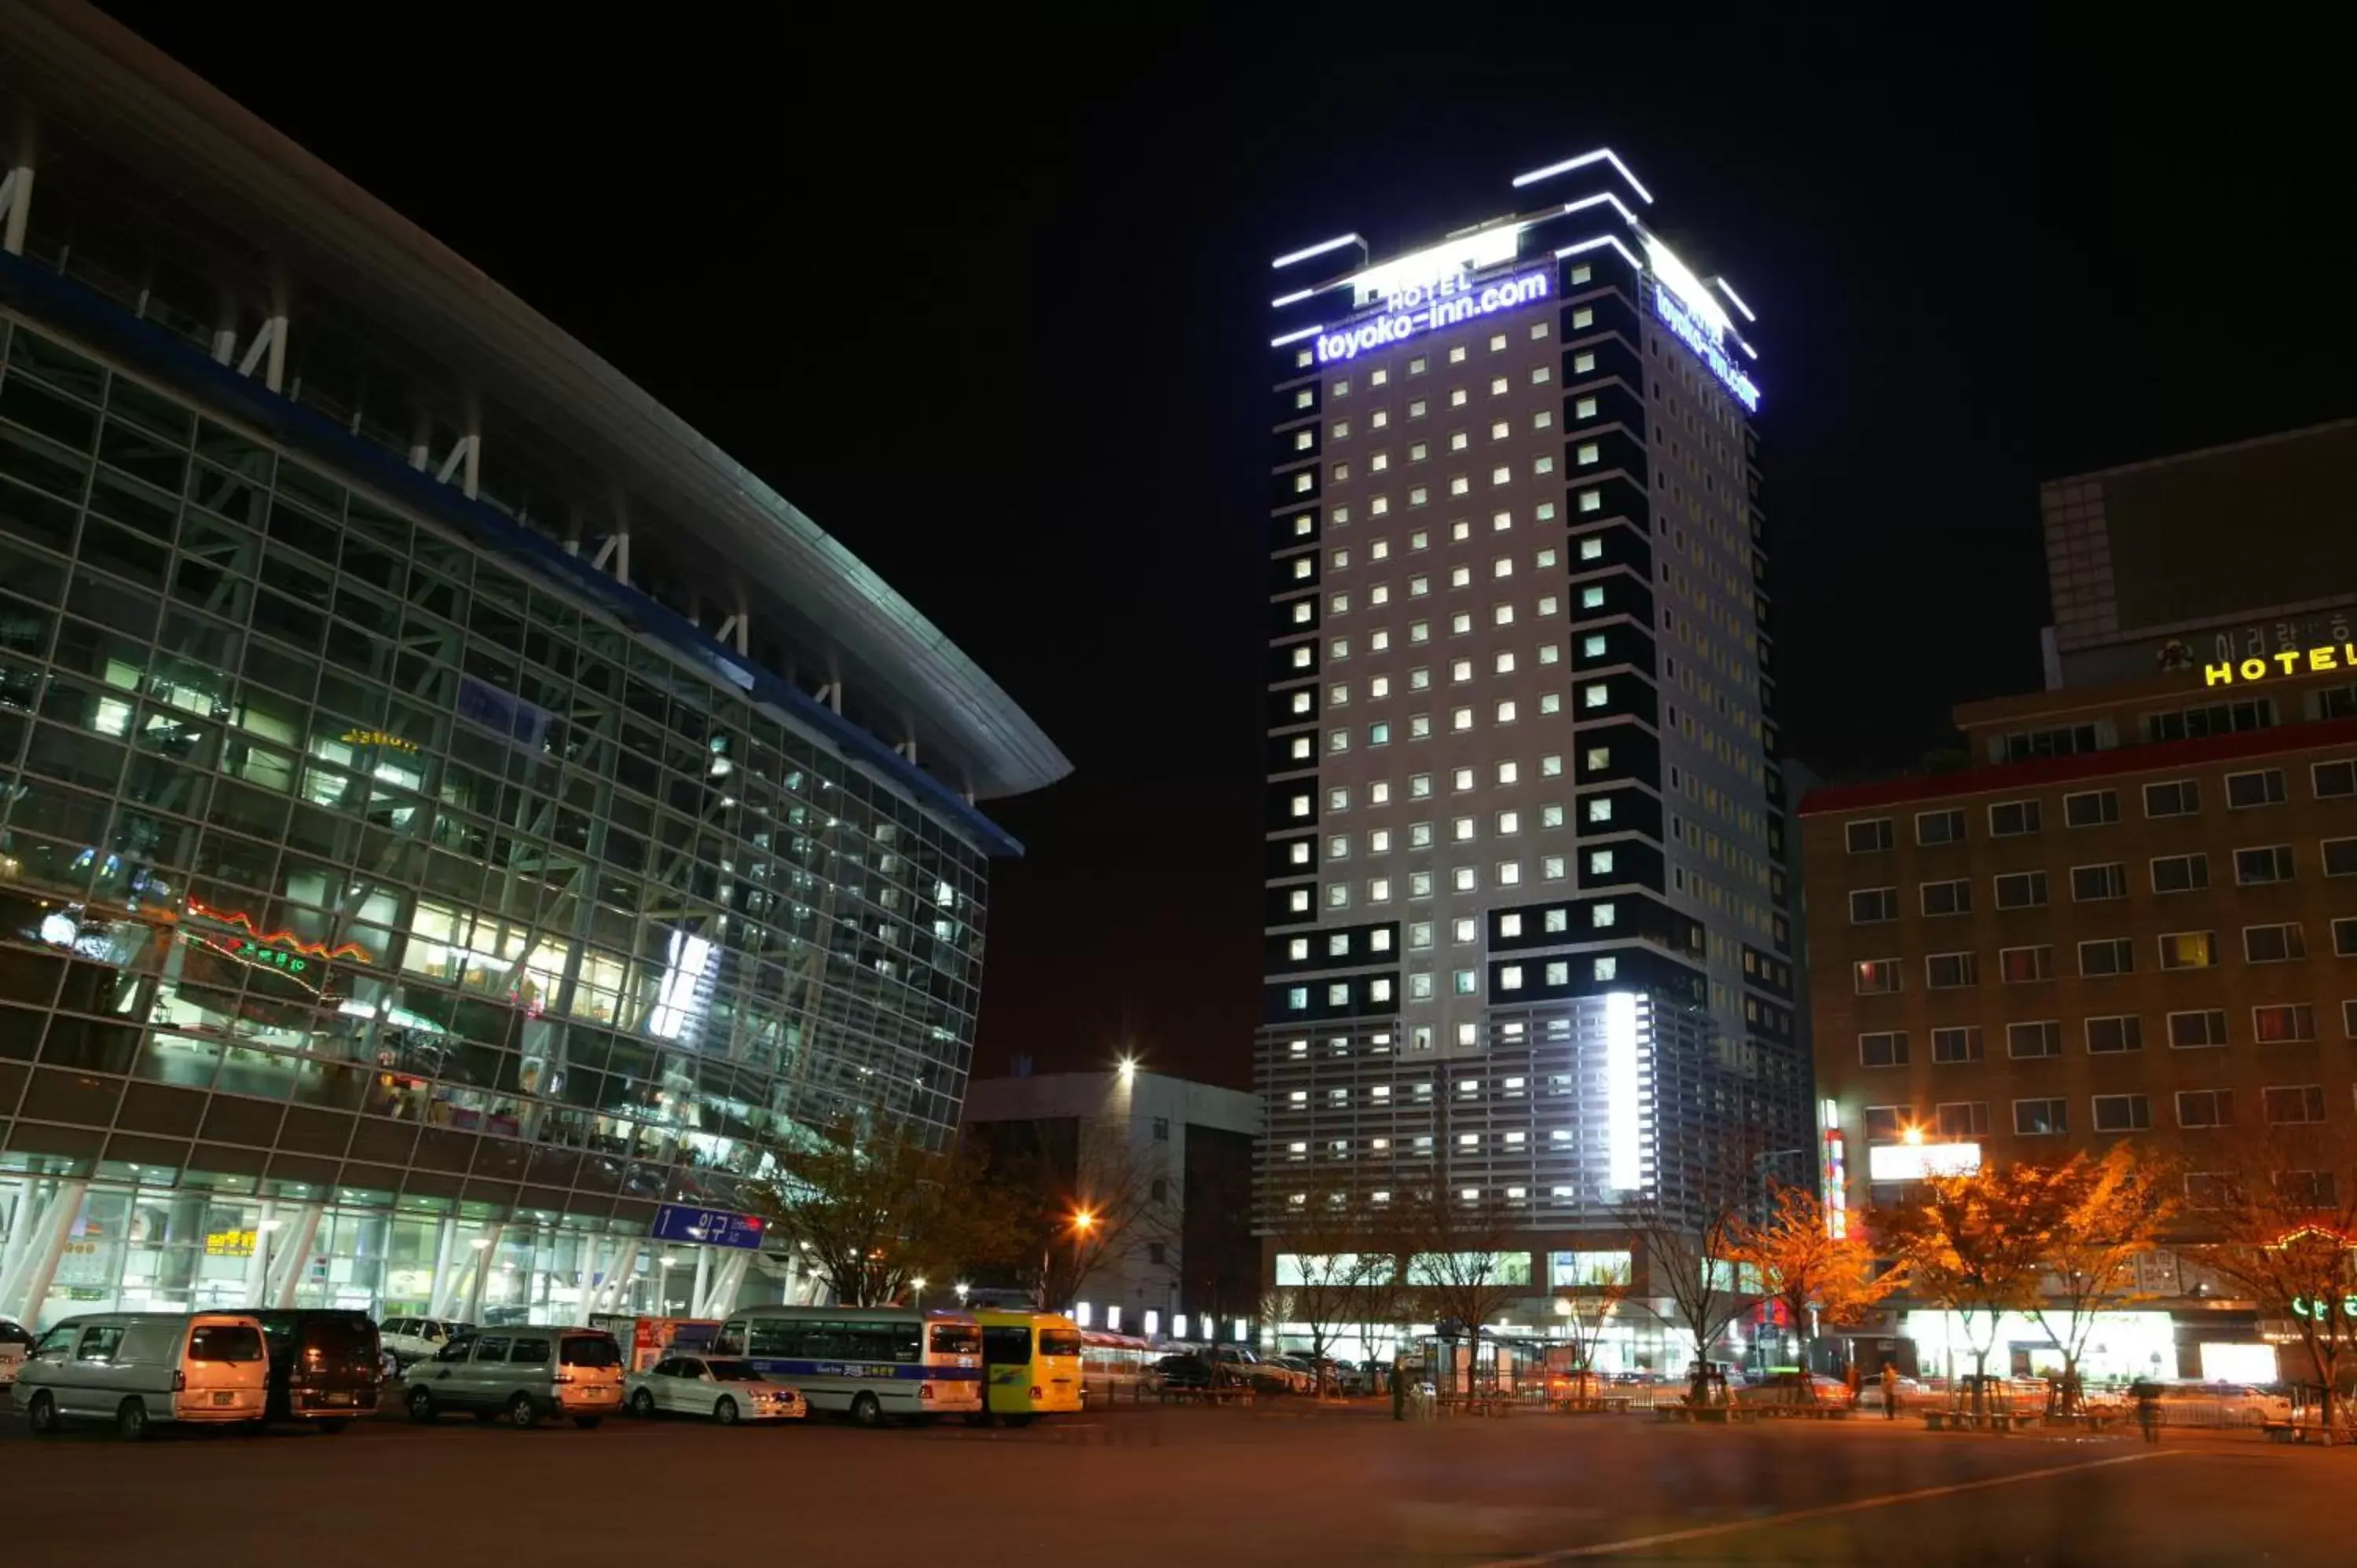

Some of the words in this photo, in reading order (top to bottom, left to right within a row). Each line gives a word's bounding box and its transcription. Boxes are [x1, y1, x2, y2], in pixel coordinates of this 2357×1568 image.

[1387, 273, 1472, 312] HOTEL
[1317, 273, 1548, 362] toyoko-inn.com
[2205, 643, 2357, 686] HOTEL
[660, 1208, 672, 1236] 1
